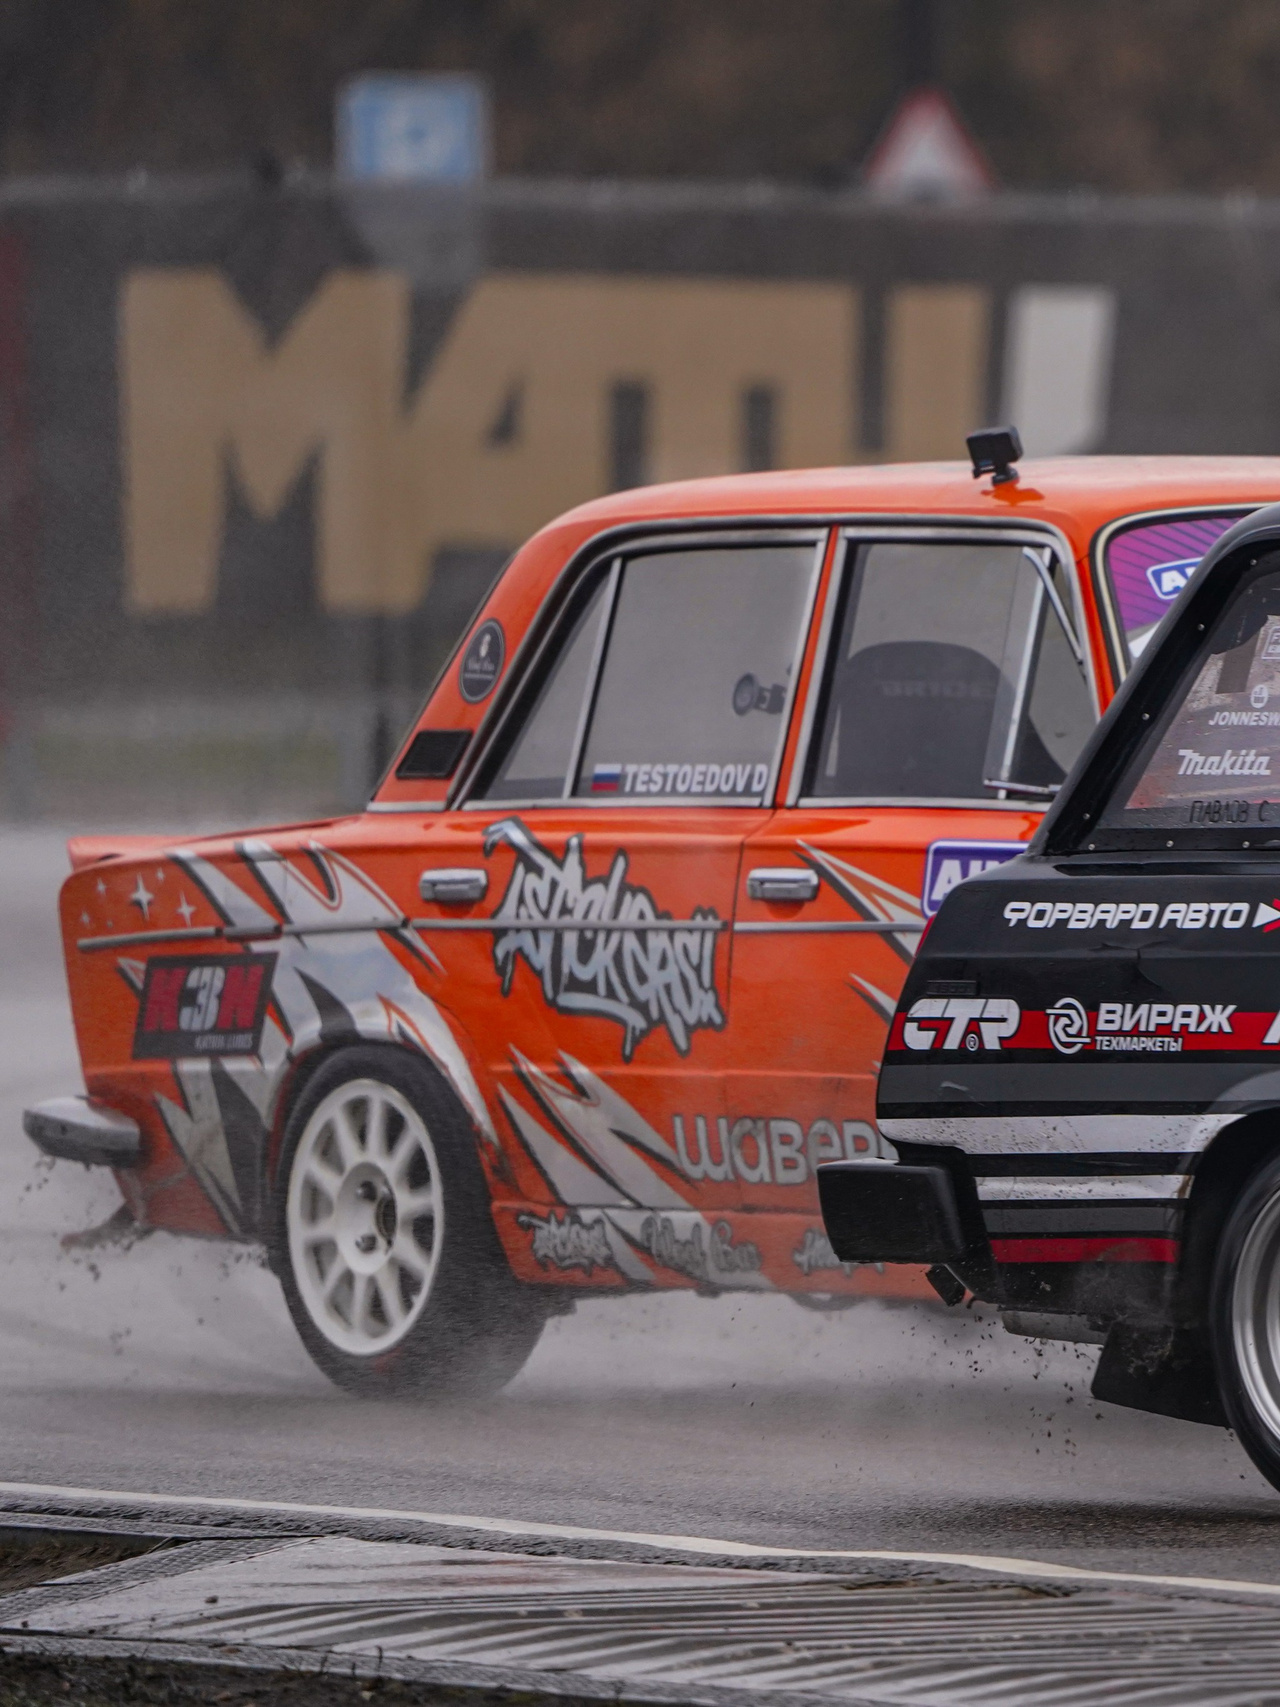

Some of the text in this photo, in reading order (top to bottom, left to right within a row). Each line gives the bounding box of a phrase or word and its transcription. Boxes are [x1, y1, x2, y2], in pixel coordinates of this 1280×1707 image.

[624, 763, 769, 793] TESTOEDOV D
[1003, 901, 1250, 930] ФОРВАРД АВТО
[903, 997, 1021, 1051] CTR
[1096, 1003, 1238, 1033] ВИРАЖ
[1095, 1035, 1184, 1052] ТЕХМАРКЕТЫ
